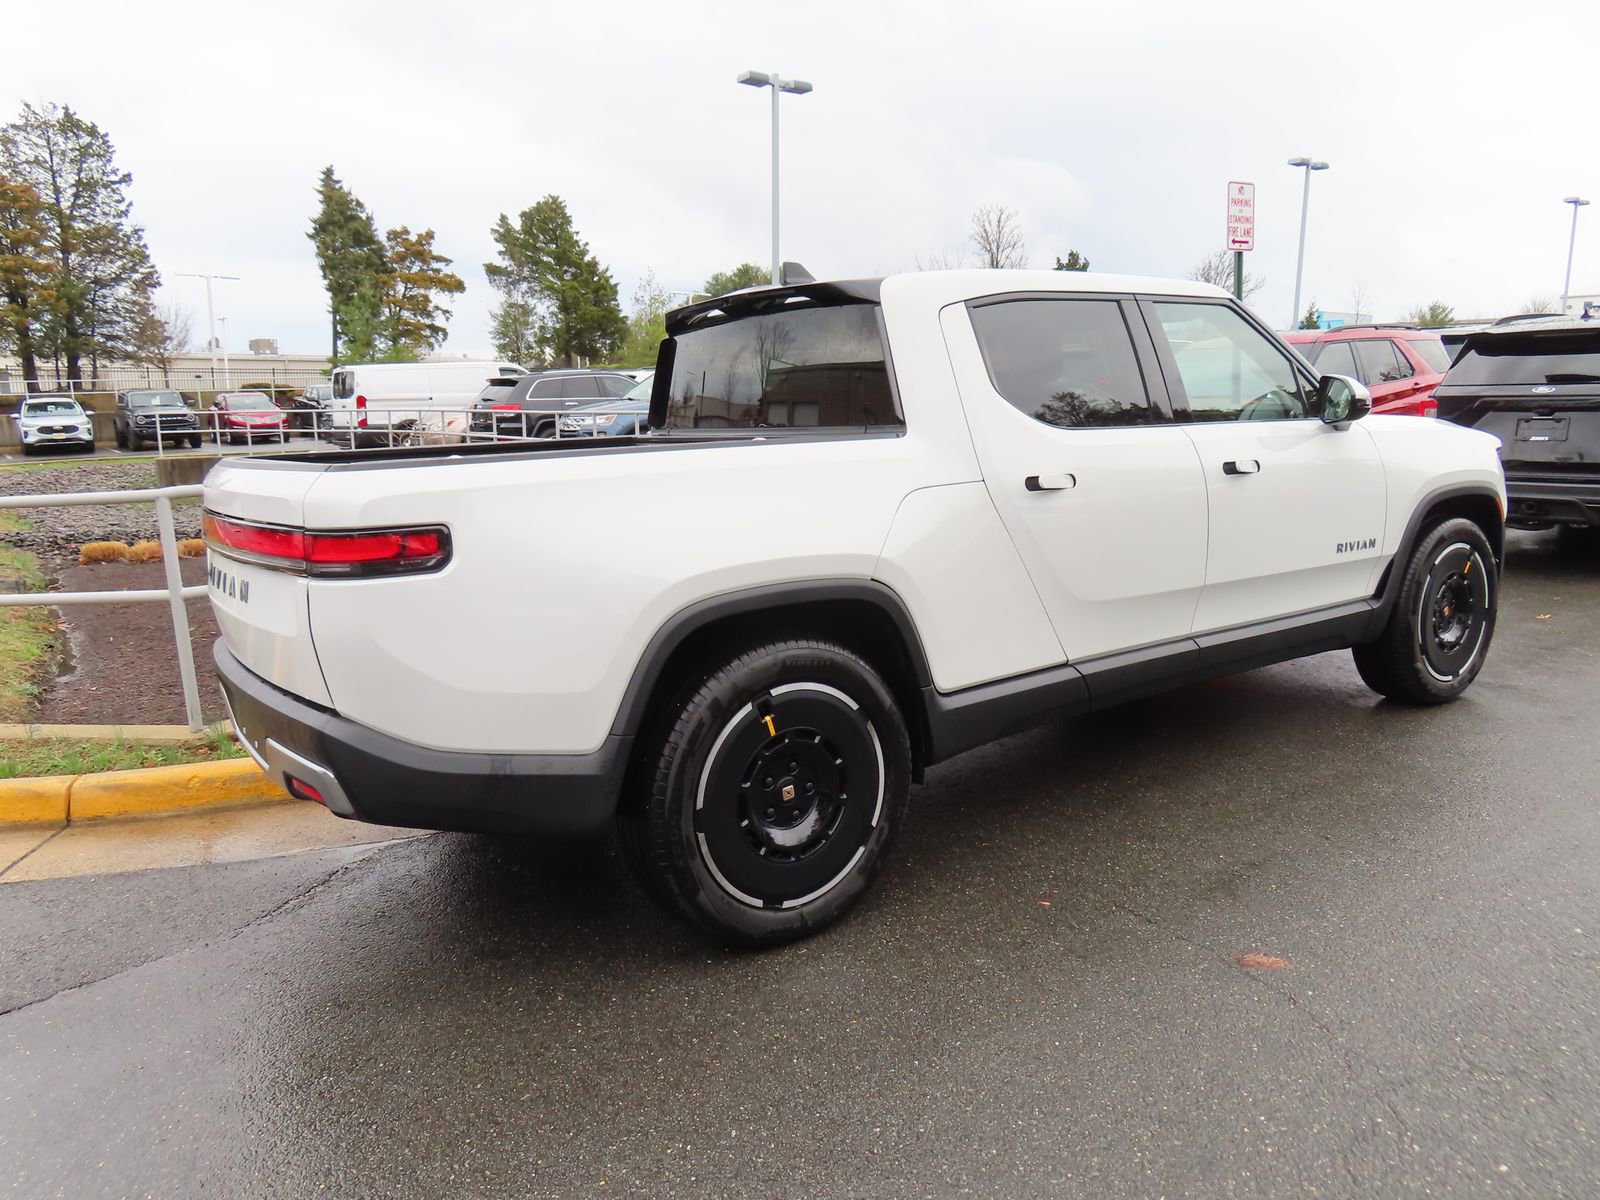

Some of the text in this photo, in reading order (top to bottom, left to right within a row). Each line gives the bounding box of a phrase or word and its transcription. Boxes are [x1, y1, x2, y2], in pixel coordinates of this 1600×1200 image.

[1231, 197, 1252, 208] PARKING
[1229, 214, 1253, 225] STANDING
[1229, 225, 1253, 239] FIRE LANE
[1336, 537, 1377, 554] RIVIAN
